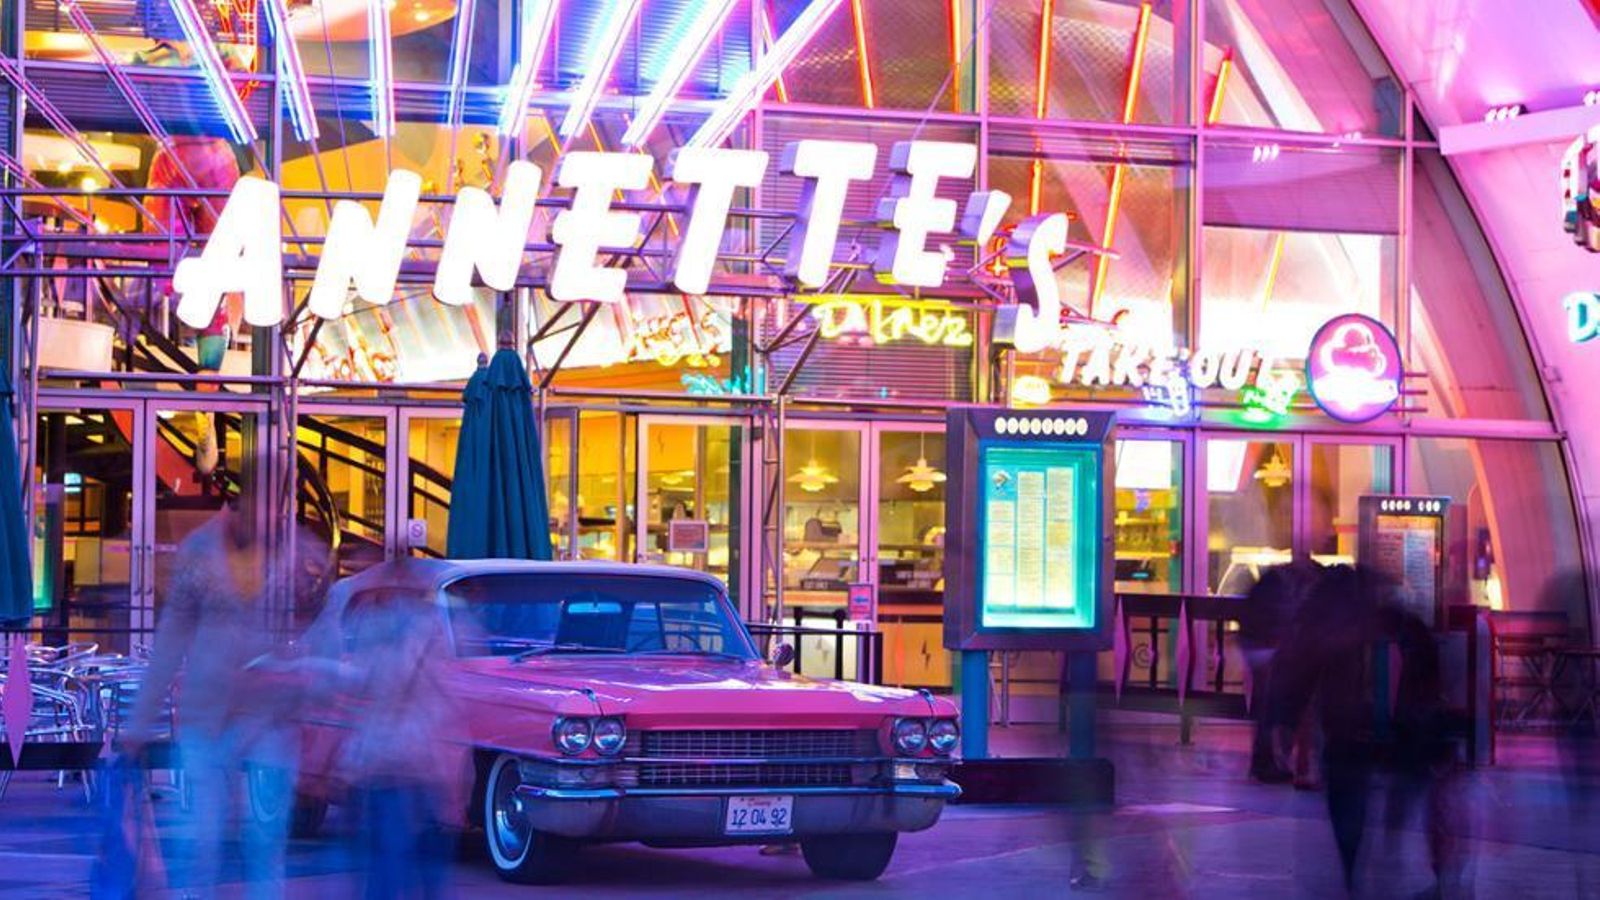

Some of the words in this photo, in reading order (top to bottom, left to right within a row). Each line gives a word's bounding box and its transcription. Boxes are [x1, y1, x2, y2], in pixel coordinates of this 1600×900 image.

[731, 809, 747, 826] 12
[751, 808, 766, 825] 04
[772, 808, 787, 826] 92
